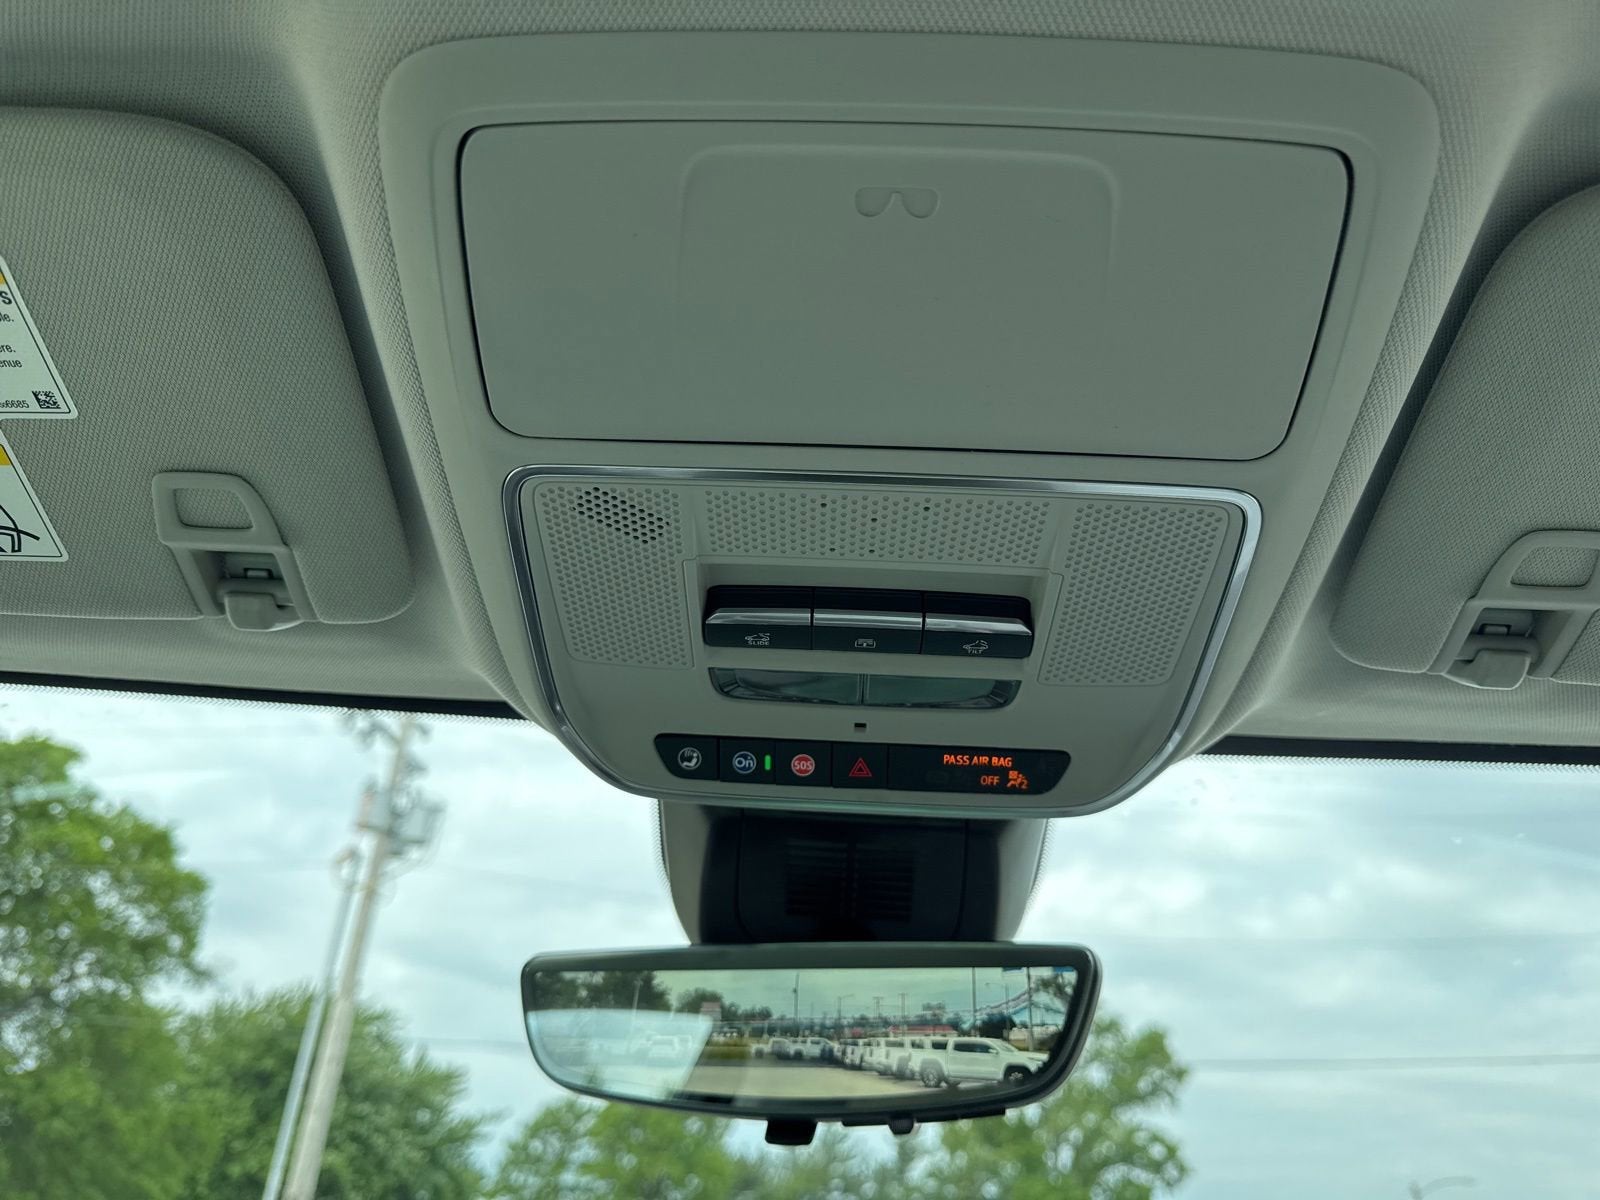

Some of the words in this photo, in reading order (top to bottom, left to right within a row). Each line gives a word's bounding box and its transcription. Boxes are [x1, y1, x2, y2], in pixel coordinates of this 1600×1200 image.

[0, 311, 14, 322] le.
[794, 760, 813, 770] SOS
[943, 754, 970, 765] PASS
[971, 755, 989, 766] AIR
[991, 756, 1012, 767] BAG
[980, 775, 1000, 786] OFF
